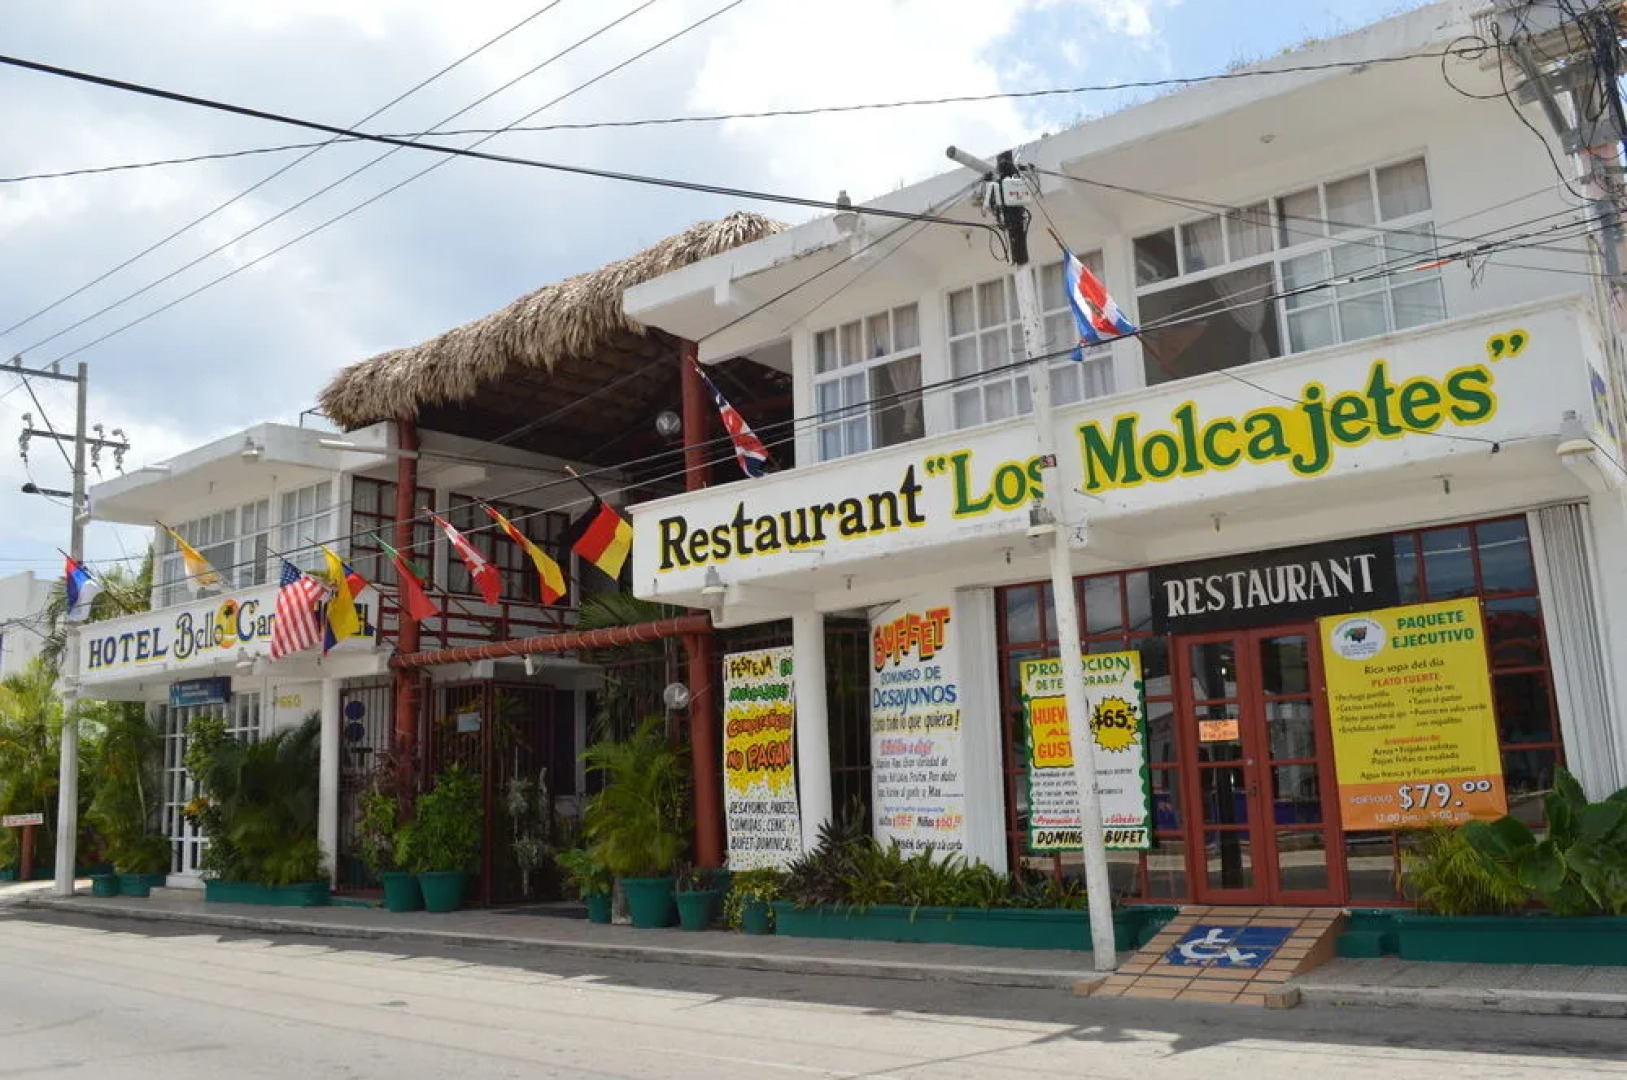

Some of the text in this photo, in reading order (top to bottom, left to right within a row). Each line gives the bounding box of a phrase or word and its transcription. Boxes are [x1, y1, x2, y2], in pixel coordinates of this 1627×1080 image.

[658, 464, 925, 570] Restaurant
[1163, 553, 1376, 618] RESTAURANT
[1396, 610, 1465, 630] PAQUETE
[89, 627, 168, 669] HOTEL
[874, 606, 951, 672] BUFFET
[1392, 627, 1475, 649] EJECUTIVO
[1026, 656, 1131, 681] PROCION
[1411, 659, 1427, 669] del
[881, 665, 942, 685] DOMINGO DE
[1371, 677, 1401, 688] PLATO
[1032, 707, 1067, 726] HUEV
[747, 741, 792, 772] PAGAN
[1038, 741, 1072, 758] GUST
[1036, 830, 1146, 845] DOMING BUFET
